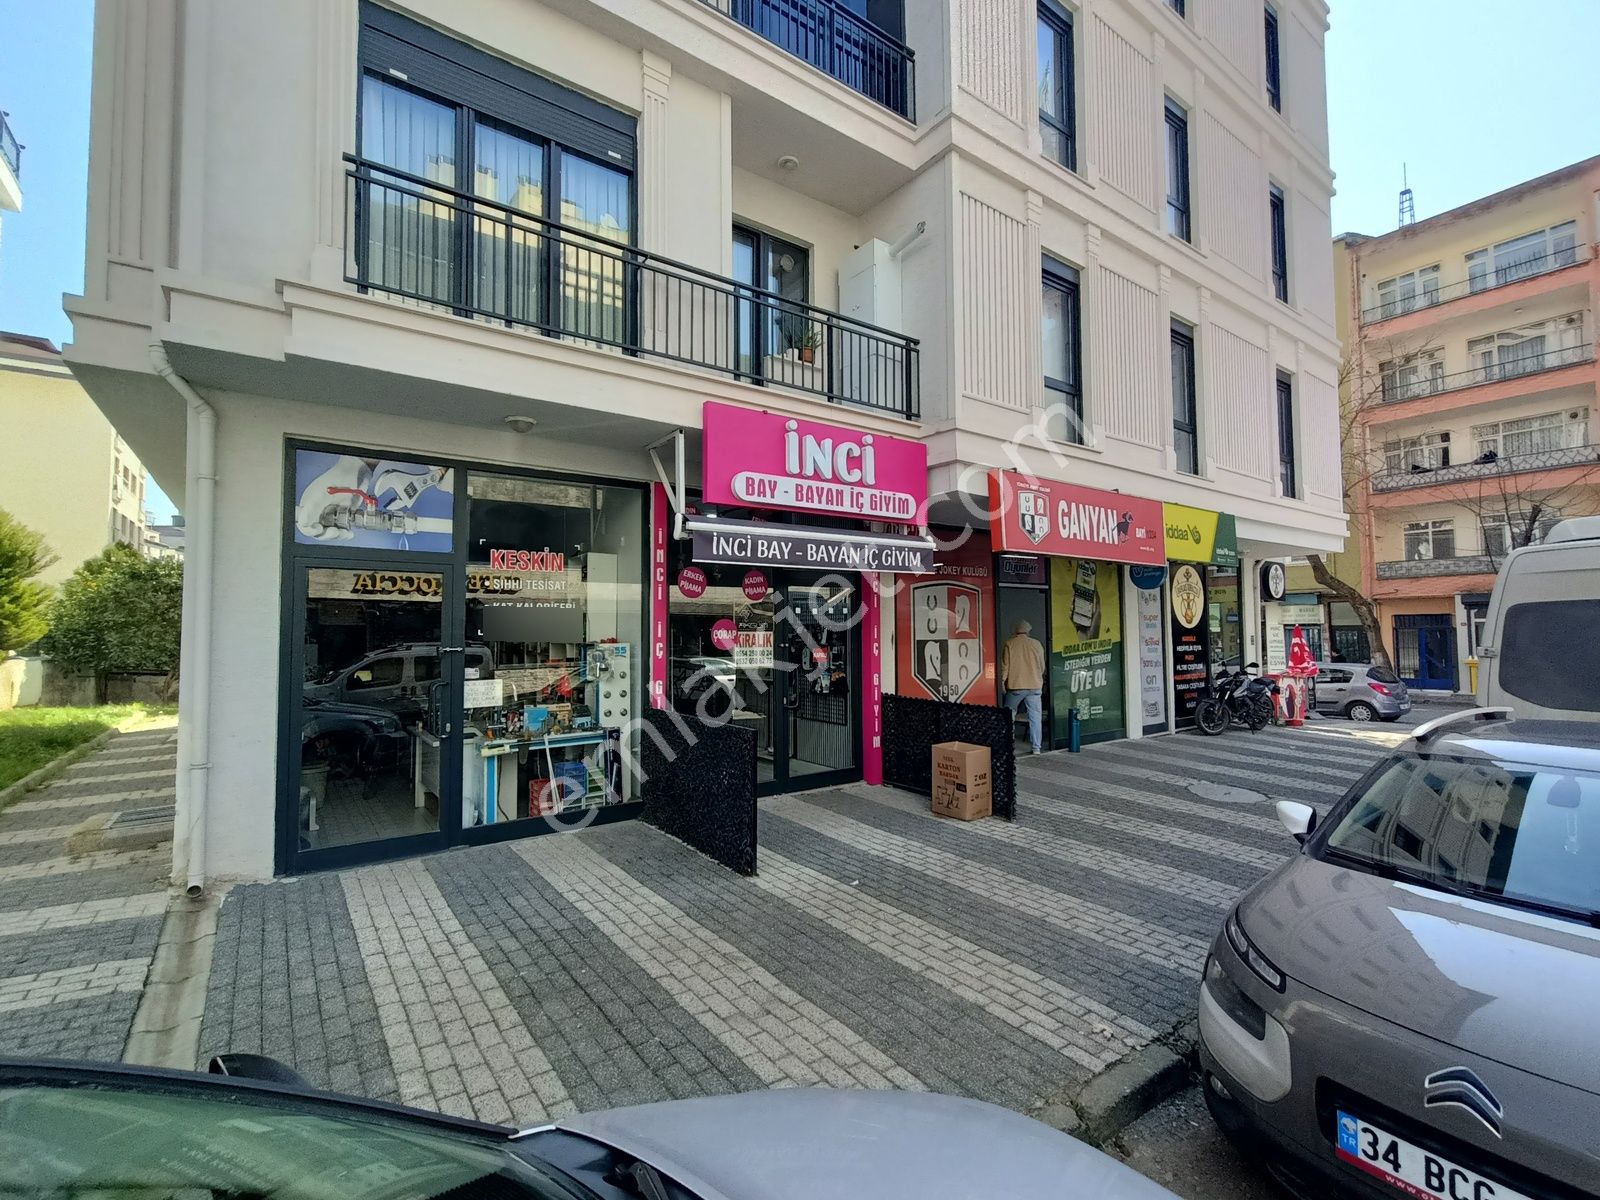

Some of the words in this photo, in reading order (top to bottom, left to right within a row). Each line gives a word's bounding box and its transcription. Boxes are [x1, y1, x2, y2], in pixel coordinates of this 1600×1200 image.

[784, 419, 876, 486] İNCİ
[745, 476, 778, 499] BAY
[795, 483, 844, 508] BAYAN
[850, 487, 864, 512] İÇ
[869, 492, 910, 516] GİYİM
[1058, 499, 1119, 545] GANYAN
[1165, 523, 1189, 541] iddaa
[712, 532, 752, 558] İNCİ
[757, 539, 792, 560] BAY
[807, 544, 860, 566] BAYAN
[865, 544, 878, 569] İÇ
[882, 547, 921, 568] GİYİM
[490, 547, 564, 572] KESKİN
[683, 569, 705, 582] ERKEK
[939, 565, 961, 575] JOKEY
[526, 579, 567, 591] TESİSAT
[744, 576, 764, 585] KADIN
[713, 629, 737, 643] ÇORAP
[736, 633, 773, 648] KİRALIK
[1071, 669, 1093, 693] ÜYE
[1094, 668, 1107, 688] OL
[939, 684, 959, 697] 1950
[937, 761, 961, 772] KARTON
[1341, 1133, 1357, 1148] TR
[1361, 1127, 1402, 1174] 34
